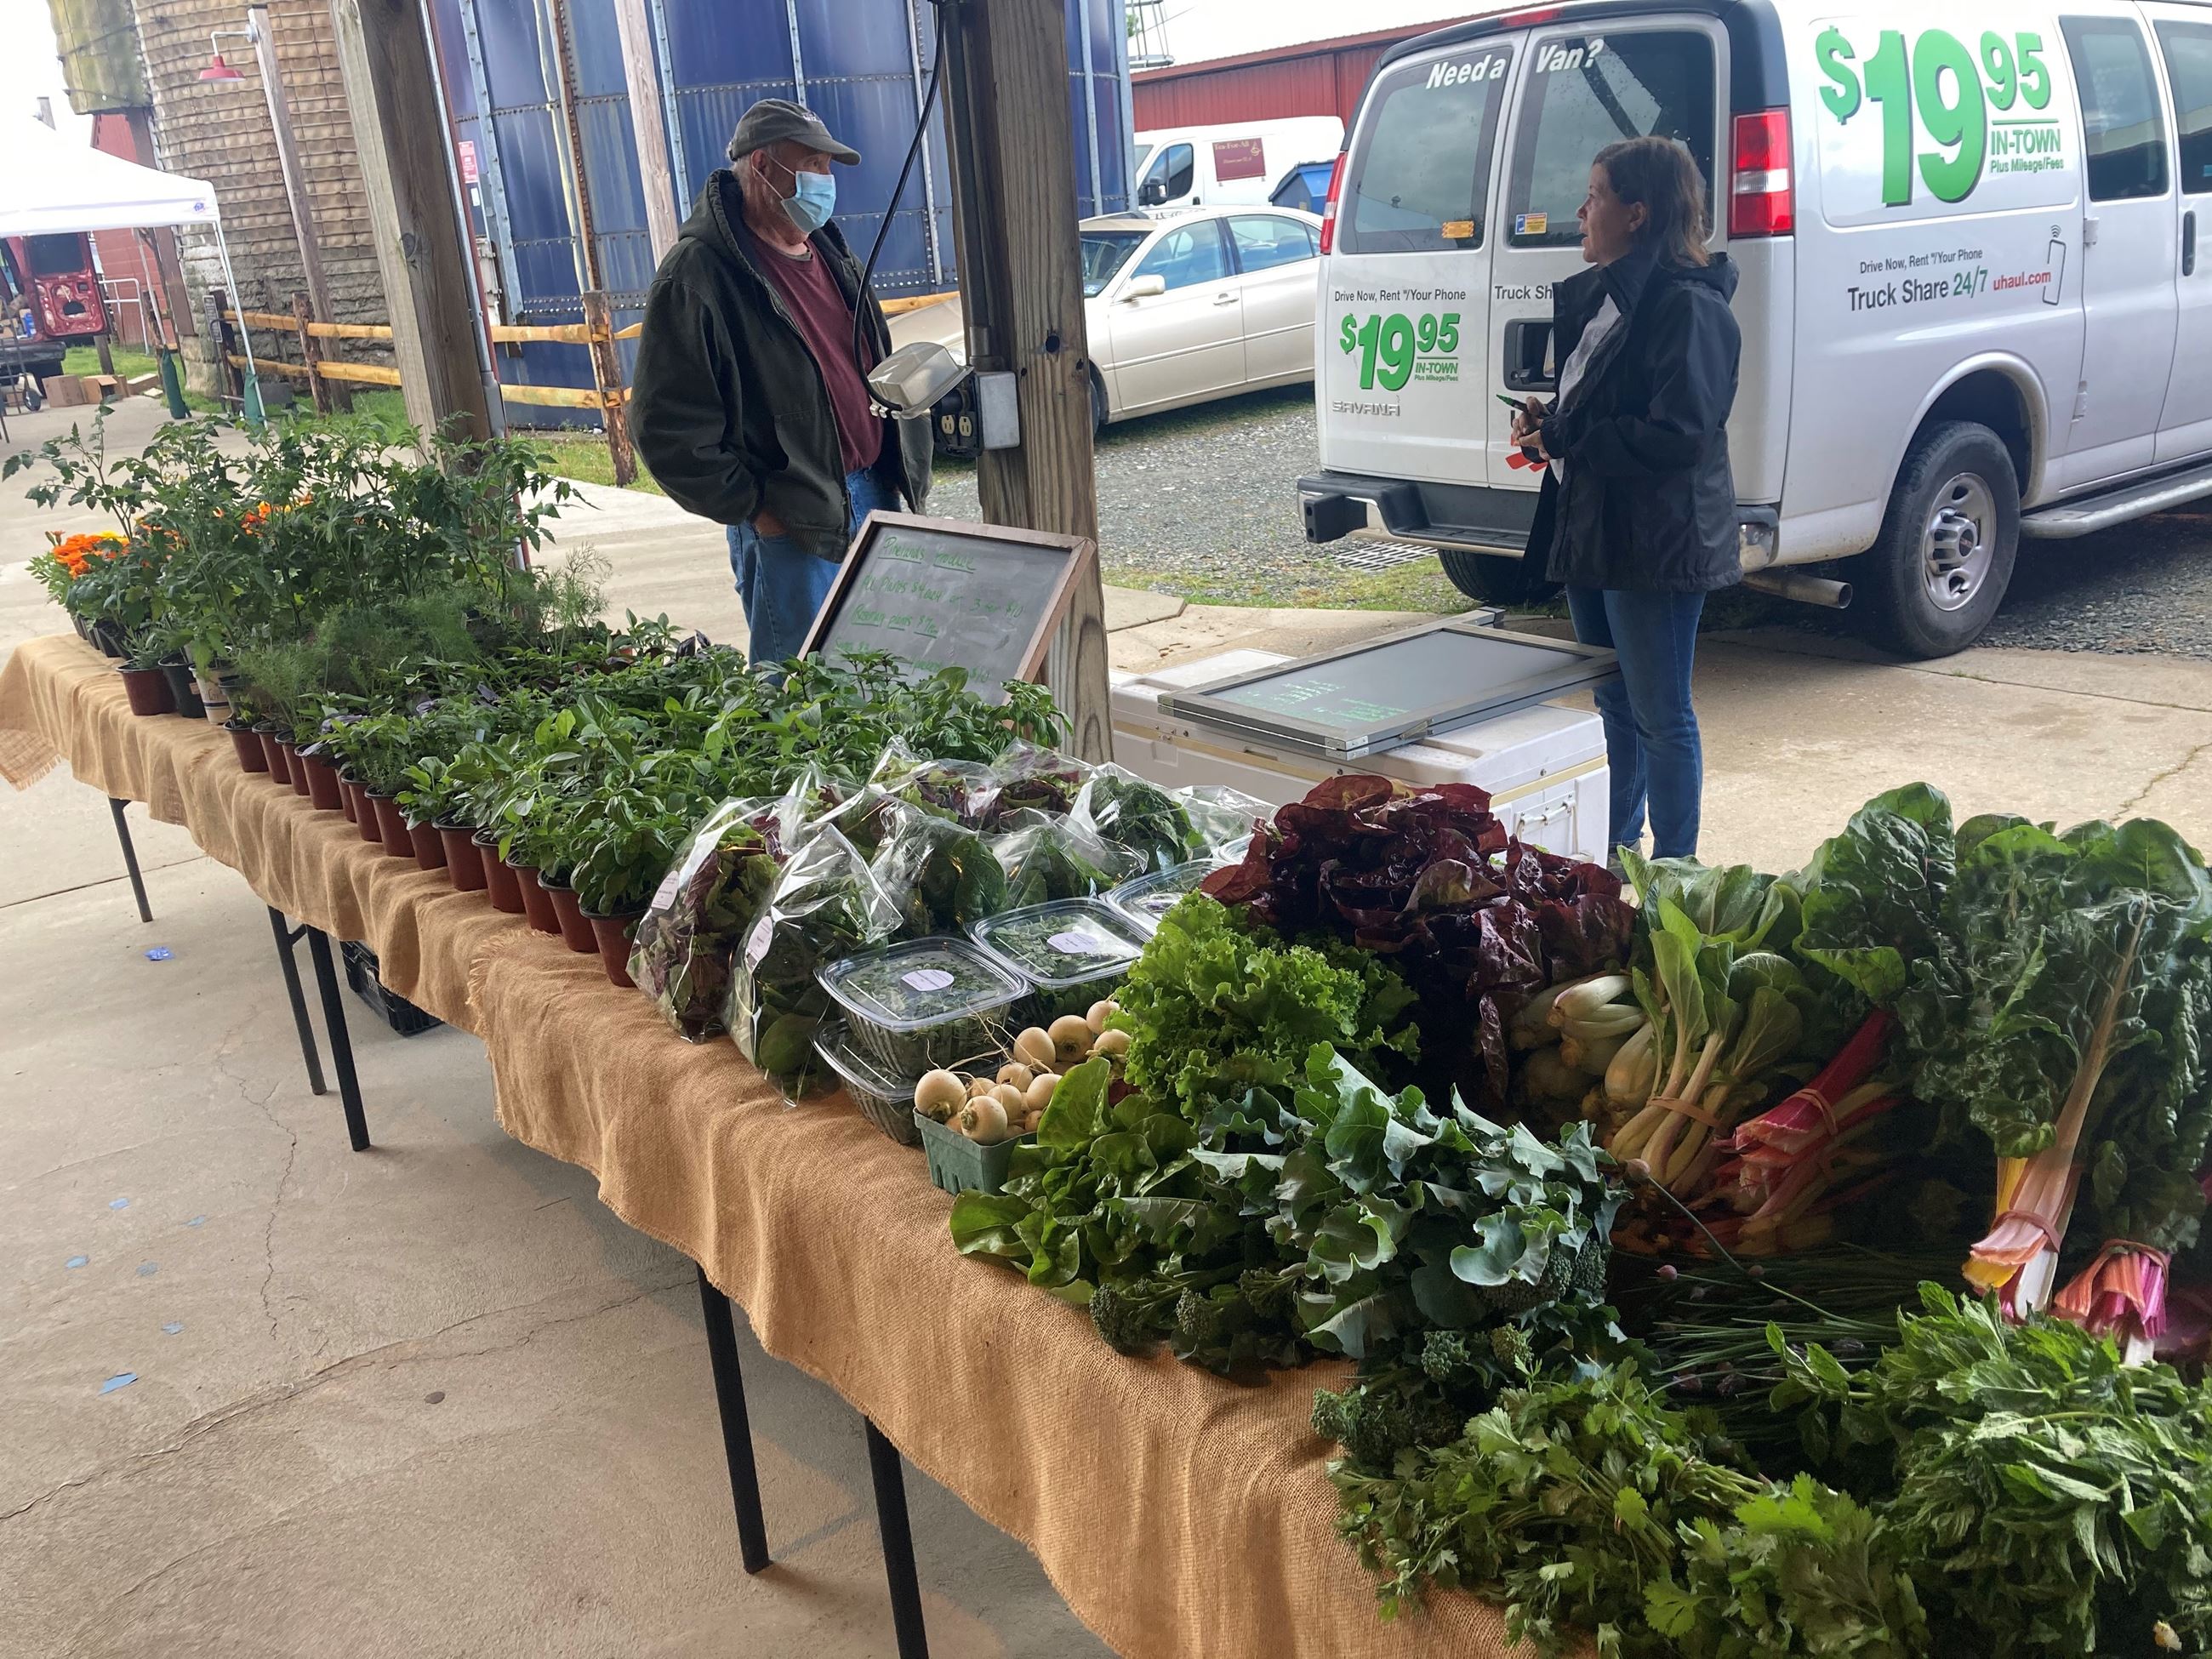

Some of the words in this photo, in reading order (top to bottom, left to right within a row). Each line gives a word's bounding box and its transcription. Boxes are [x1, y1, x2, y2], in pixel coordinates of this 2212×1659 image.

[1536, 38, 1605, 74] Van?
[1425, 54, 1492, 89] Need
[1489, 58, 1507, 80] a
[1991, 128, 2061, 155] IN-TOWN
[1990, 159, 2010, 173] Plus
[2010, 157, 2065, 173] Mileage/Fees
[1860, 260, 1884, 274] Drive
[1885, 258, 1907, 271] Now,
[1909, 254, 1930, 267] Rent
[1958, 248, 1983, 261] Phone
[1334, 291, 1354, 301] Drive
[1356, 290, 1377, 303] Now,
[1380, 289, 1400, 301] Rent
[1434, 288, 1467, 299] Phone
[1495, 286, 1531, 299] Truck
[1535, 285, 1554, 299] Sh
[1847, 282, 1898, 311] Truck
[1901, 278, 1950, 304] Share
[1953, 265, 1988, 299] 24/7
[1993, 271, 2052, 291] uhaul.com
[1415, 362, 1459, 373] IN-TOWN
[1332, 400, 1400, 416] SAVANA
